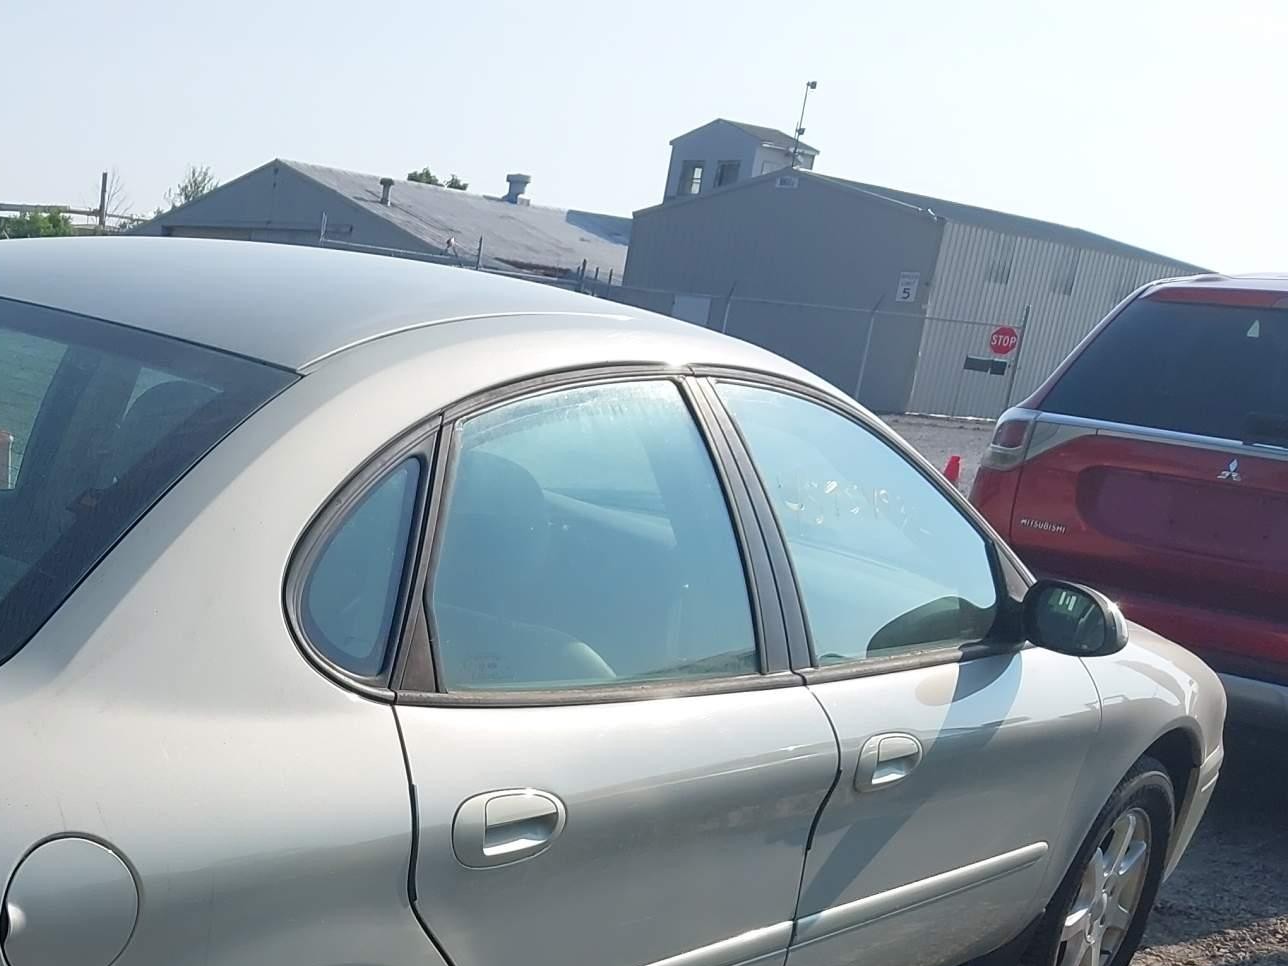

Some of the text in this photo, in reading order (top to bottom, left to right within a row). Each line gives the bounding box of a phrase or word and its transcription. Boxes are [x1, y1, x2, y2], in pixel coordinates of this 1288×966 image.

[901, 287, 911, 300] 5
[991, 334, 1017, 348] STOP
[1020, 519, 1067, 534] MITSUBISHI
